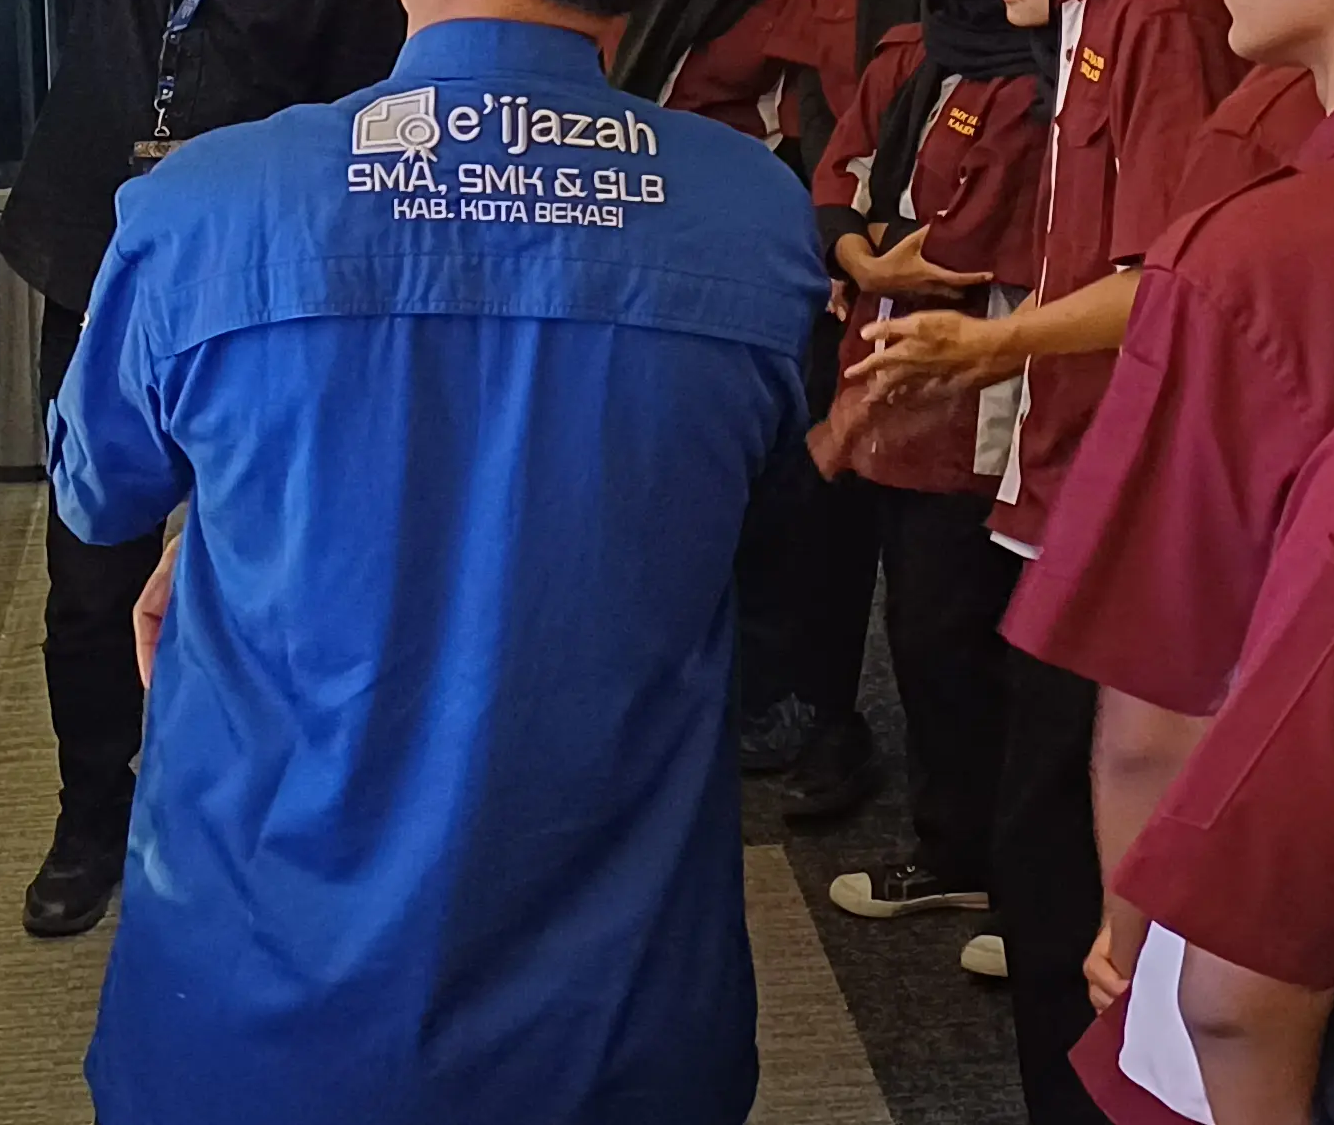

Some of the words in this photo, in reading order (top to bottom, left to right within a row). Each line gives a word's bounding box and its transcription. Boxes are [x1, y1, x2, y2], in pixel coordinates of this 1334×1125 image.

[348, 162, 447, 196] SMA,
[459, 164, 544, 196] SMK
[554, 168, 588, 197] &
[594, 168, 665, 202] SLB
[393, 197, 455, 220] KAB.
[460, 199, 528, 223] KOTA
[534, 203, 624, 228] BEKASI
